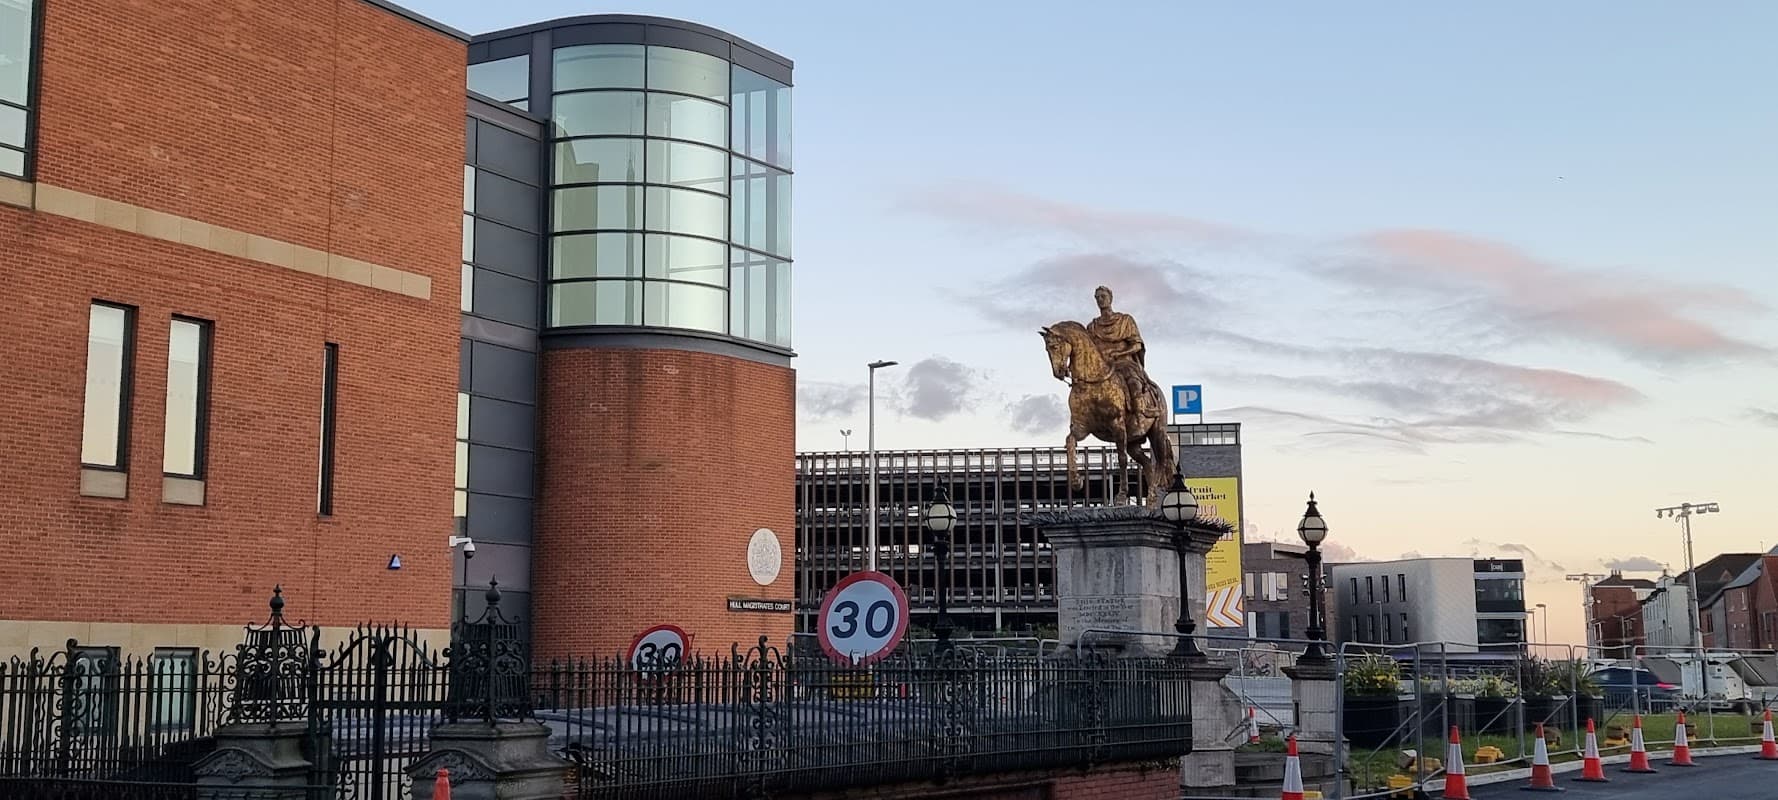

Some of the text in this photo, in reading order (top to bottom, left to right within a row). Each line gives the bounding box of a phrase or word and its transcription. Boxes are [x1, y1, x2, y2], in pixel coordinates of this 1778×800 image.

[1177, 390, 1198, 409] P
[730, 601, 742, 609] HULL
[743, 602, 774, 610] MAGISTRATES
[831, 600, 895, 638] 30
